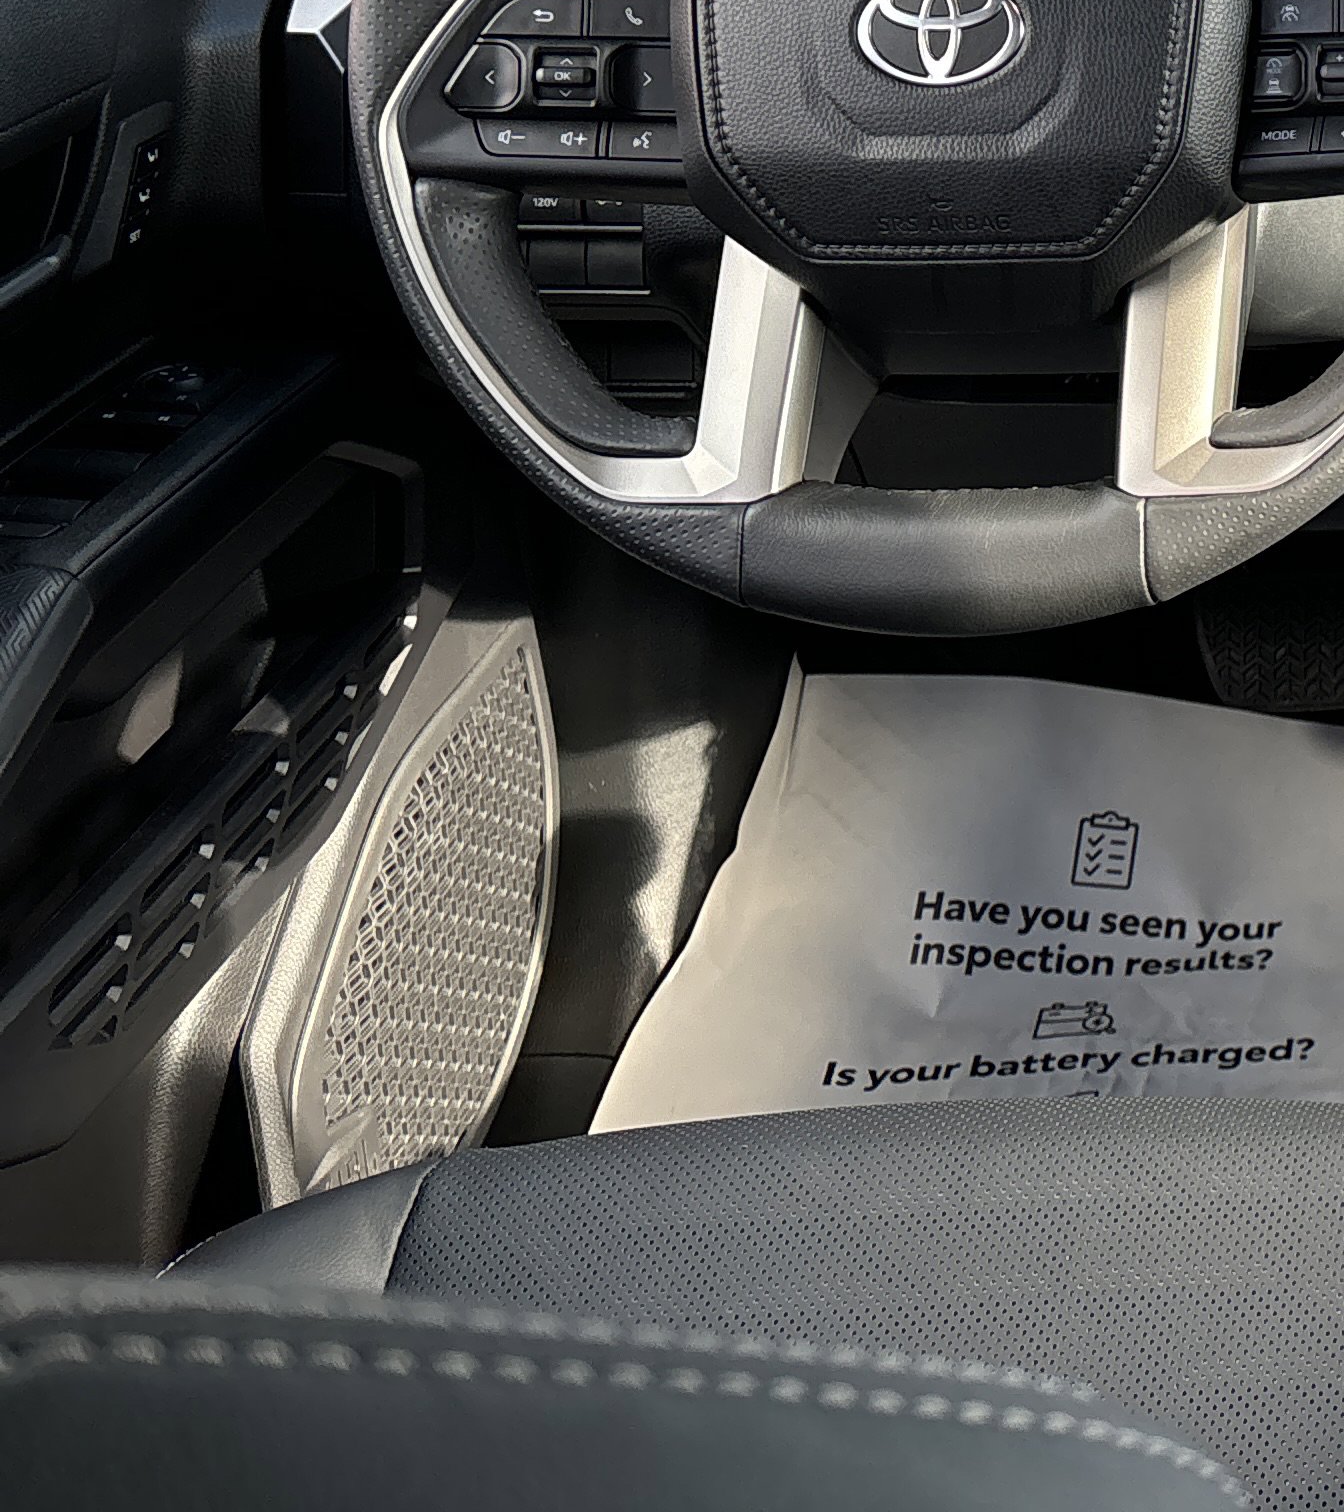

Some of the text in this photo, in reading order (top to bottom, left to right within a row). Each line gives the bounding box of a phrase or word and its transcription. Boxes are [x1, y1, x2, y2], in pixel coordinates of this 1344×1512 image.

[553, 71, 572, 81] OK
[1261, 129, 1297, 141] MODE
[533, 197, 559, 207] 120V
[914, 890, 1284, 948] Have you seen your
[908, 933, 1274, 977] inspection results?
[821, 1036, 1316, 1093] Is your battery charged?
